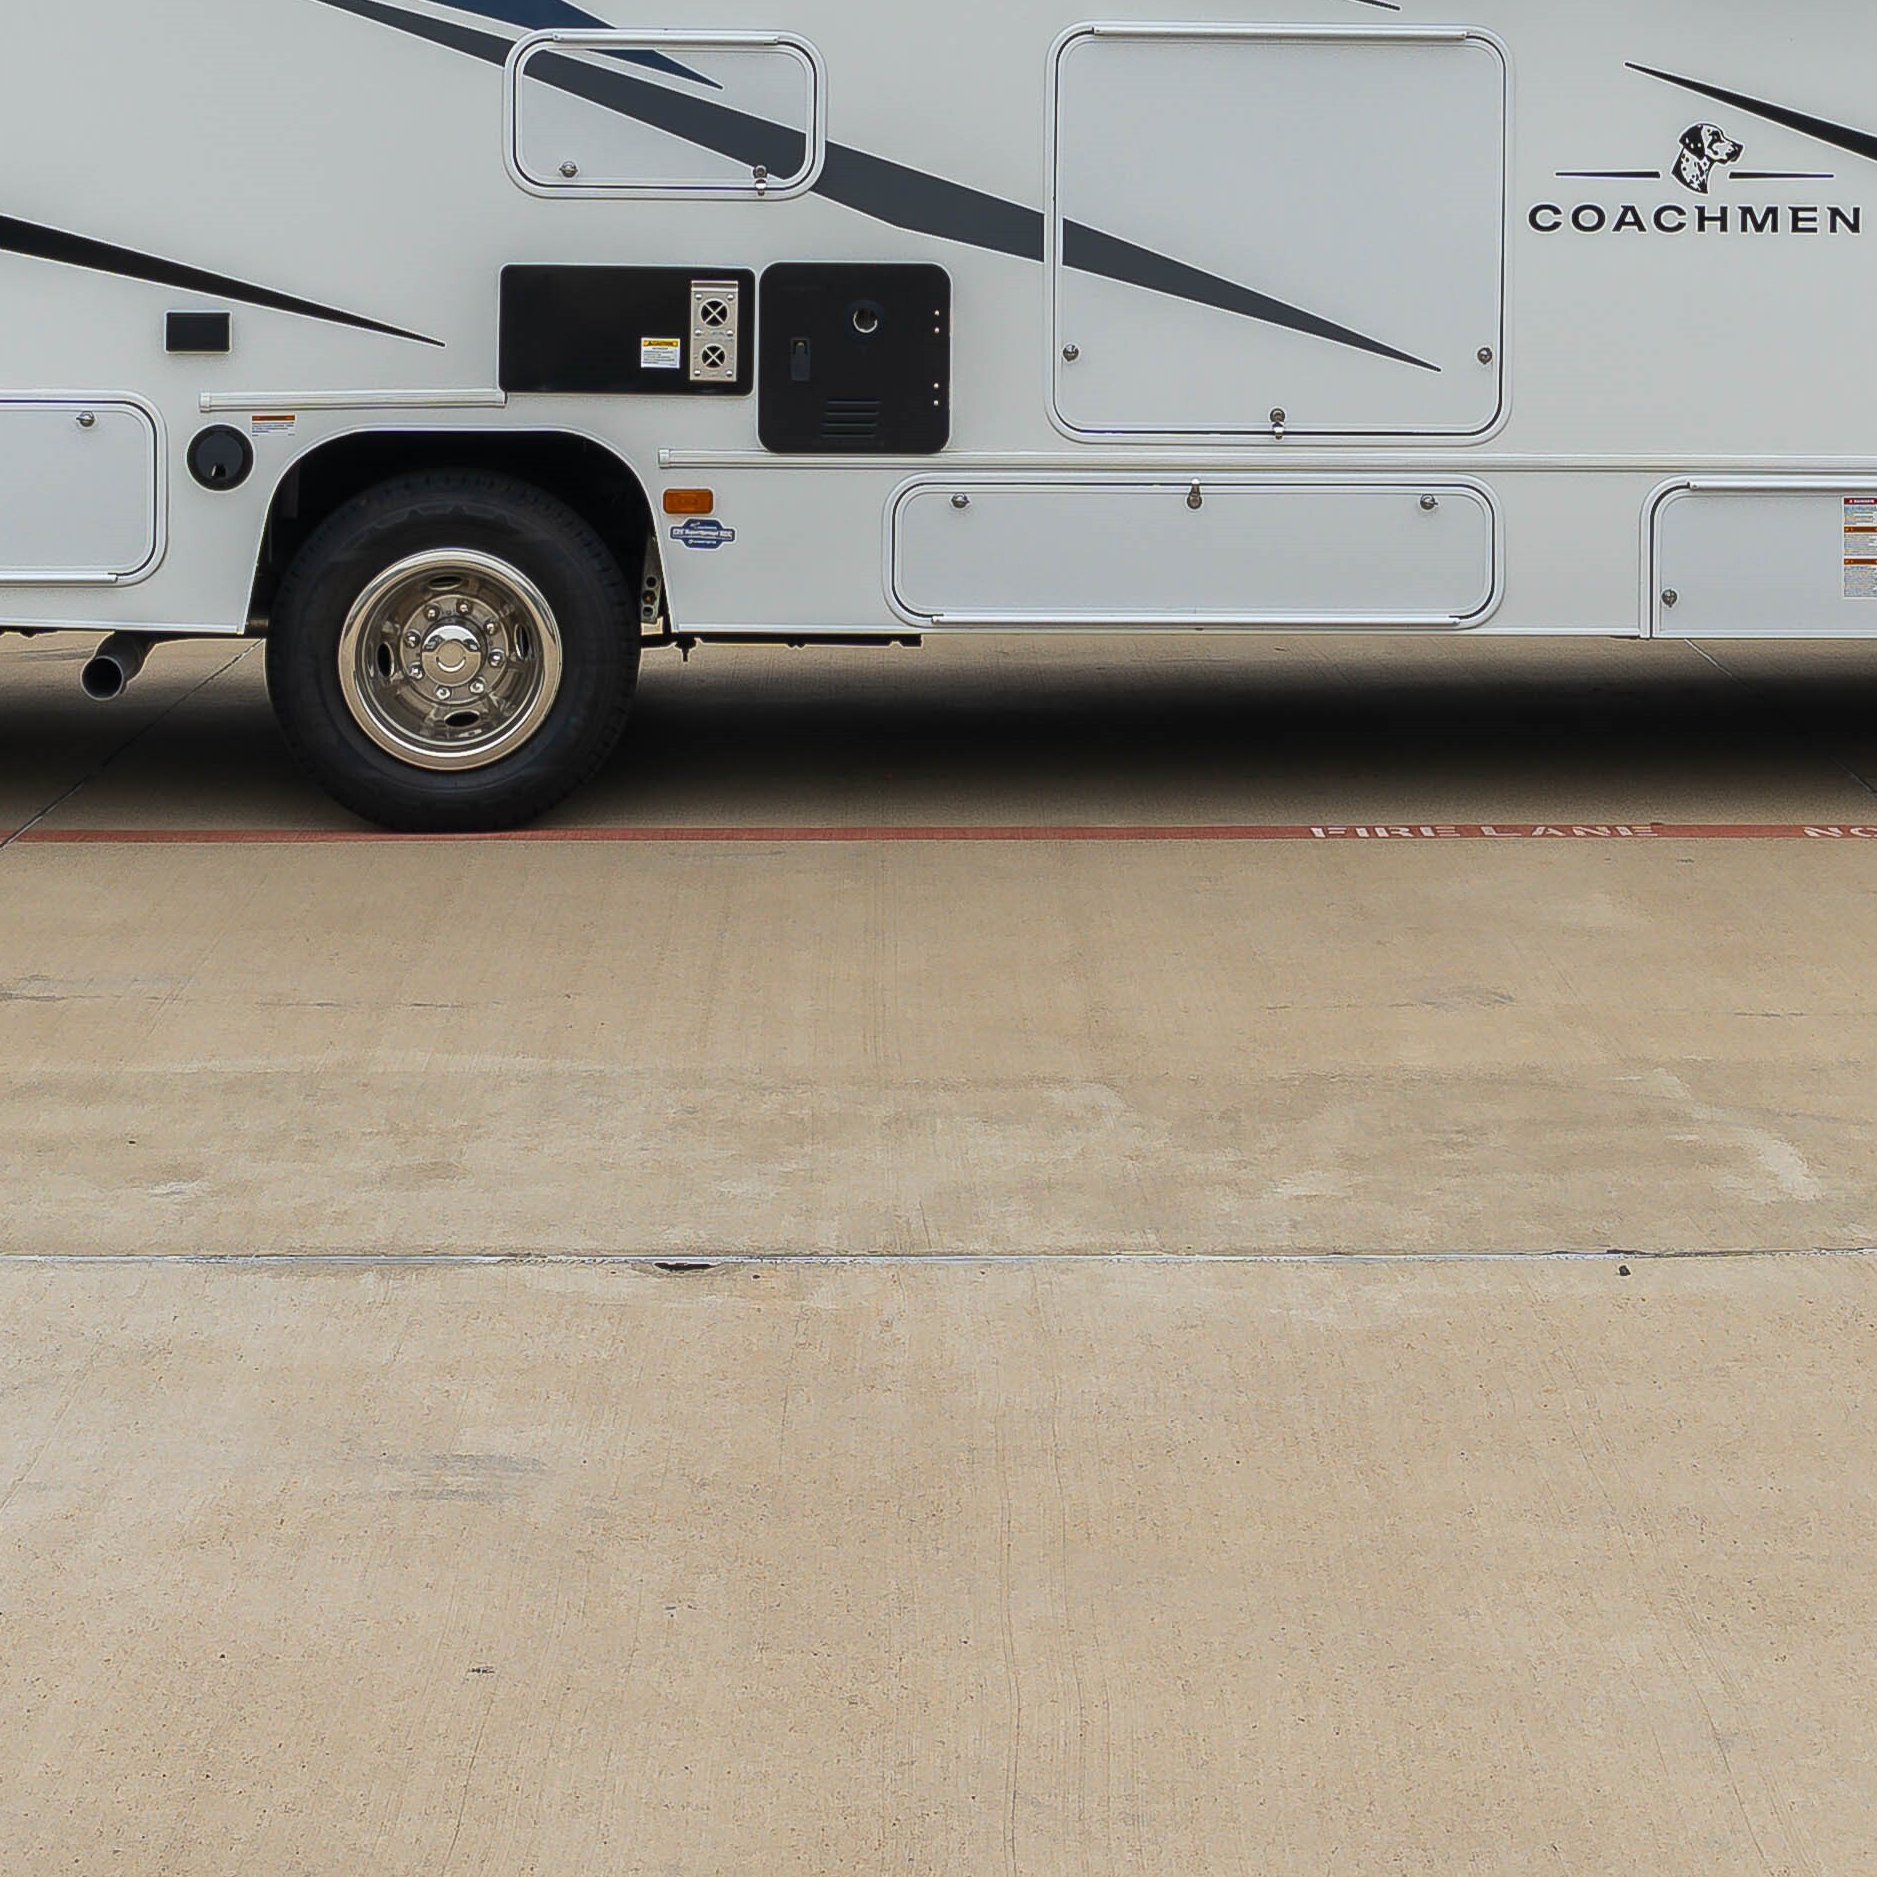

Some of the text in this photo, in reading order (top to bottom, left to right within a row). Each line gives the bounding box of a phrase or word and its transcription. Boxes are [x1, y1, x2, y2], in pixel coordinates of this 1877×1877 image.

[1527, 203, 1861, 234] COACHMEN
[1310, 826, 1460, 837] FIRE
[1480, 826, 1659, 837] LANE
